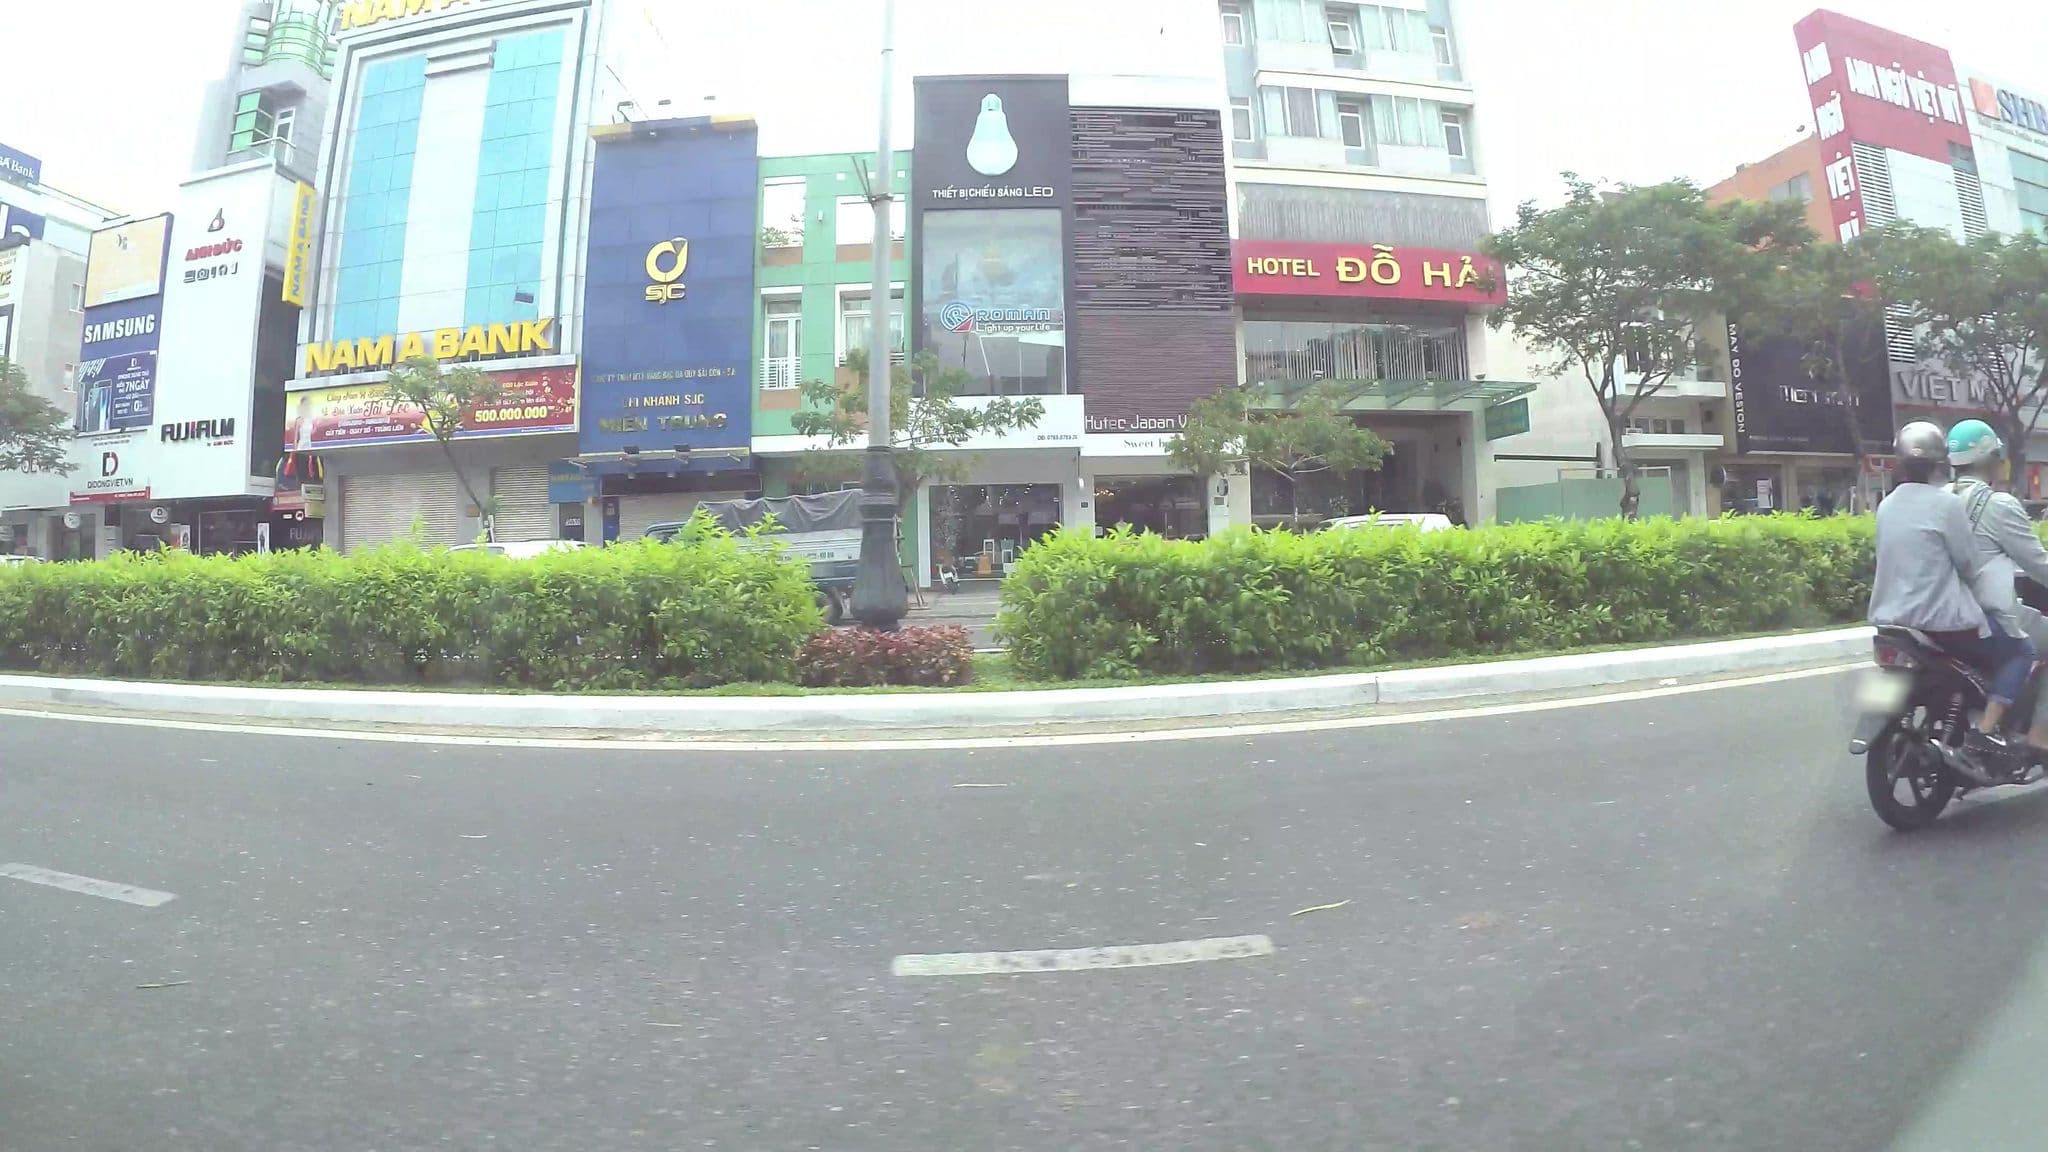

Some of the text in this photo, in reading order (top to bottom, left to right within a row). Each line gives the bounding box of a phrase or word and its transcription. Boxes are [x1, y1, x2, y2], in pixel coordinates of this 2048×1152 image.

[932, 184, 1054, 200] THIẾT BỊ CHIẾU SÁNG LED
[1247, 257, 1321, 277] HOTEL
[1336, 244, 1402, 285] ĐỖ
[645, 283, 686, 304] SJC
[975, 308, 1050, 321] ROMAN
[84, 314, 155, 344] SAMSUNG
[976, 322, 1001, 334] Light
[305, 318, 554, 373] NAM A BANK
[1728, 323, 1739, 353] MAY
[1734, 382, 1746, 433] VESTON
[684, 393, 705, 405] SJC
[475, 405, 548, 423] 500.000.000
[1131, 414, 1174, 430] Japan
[161, 418, 235, 441] FUJIFILM
[1124, 439, 1153, 449] Sweet
[87, 478, 134, 489] DIDONGVIET.VN
